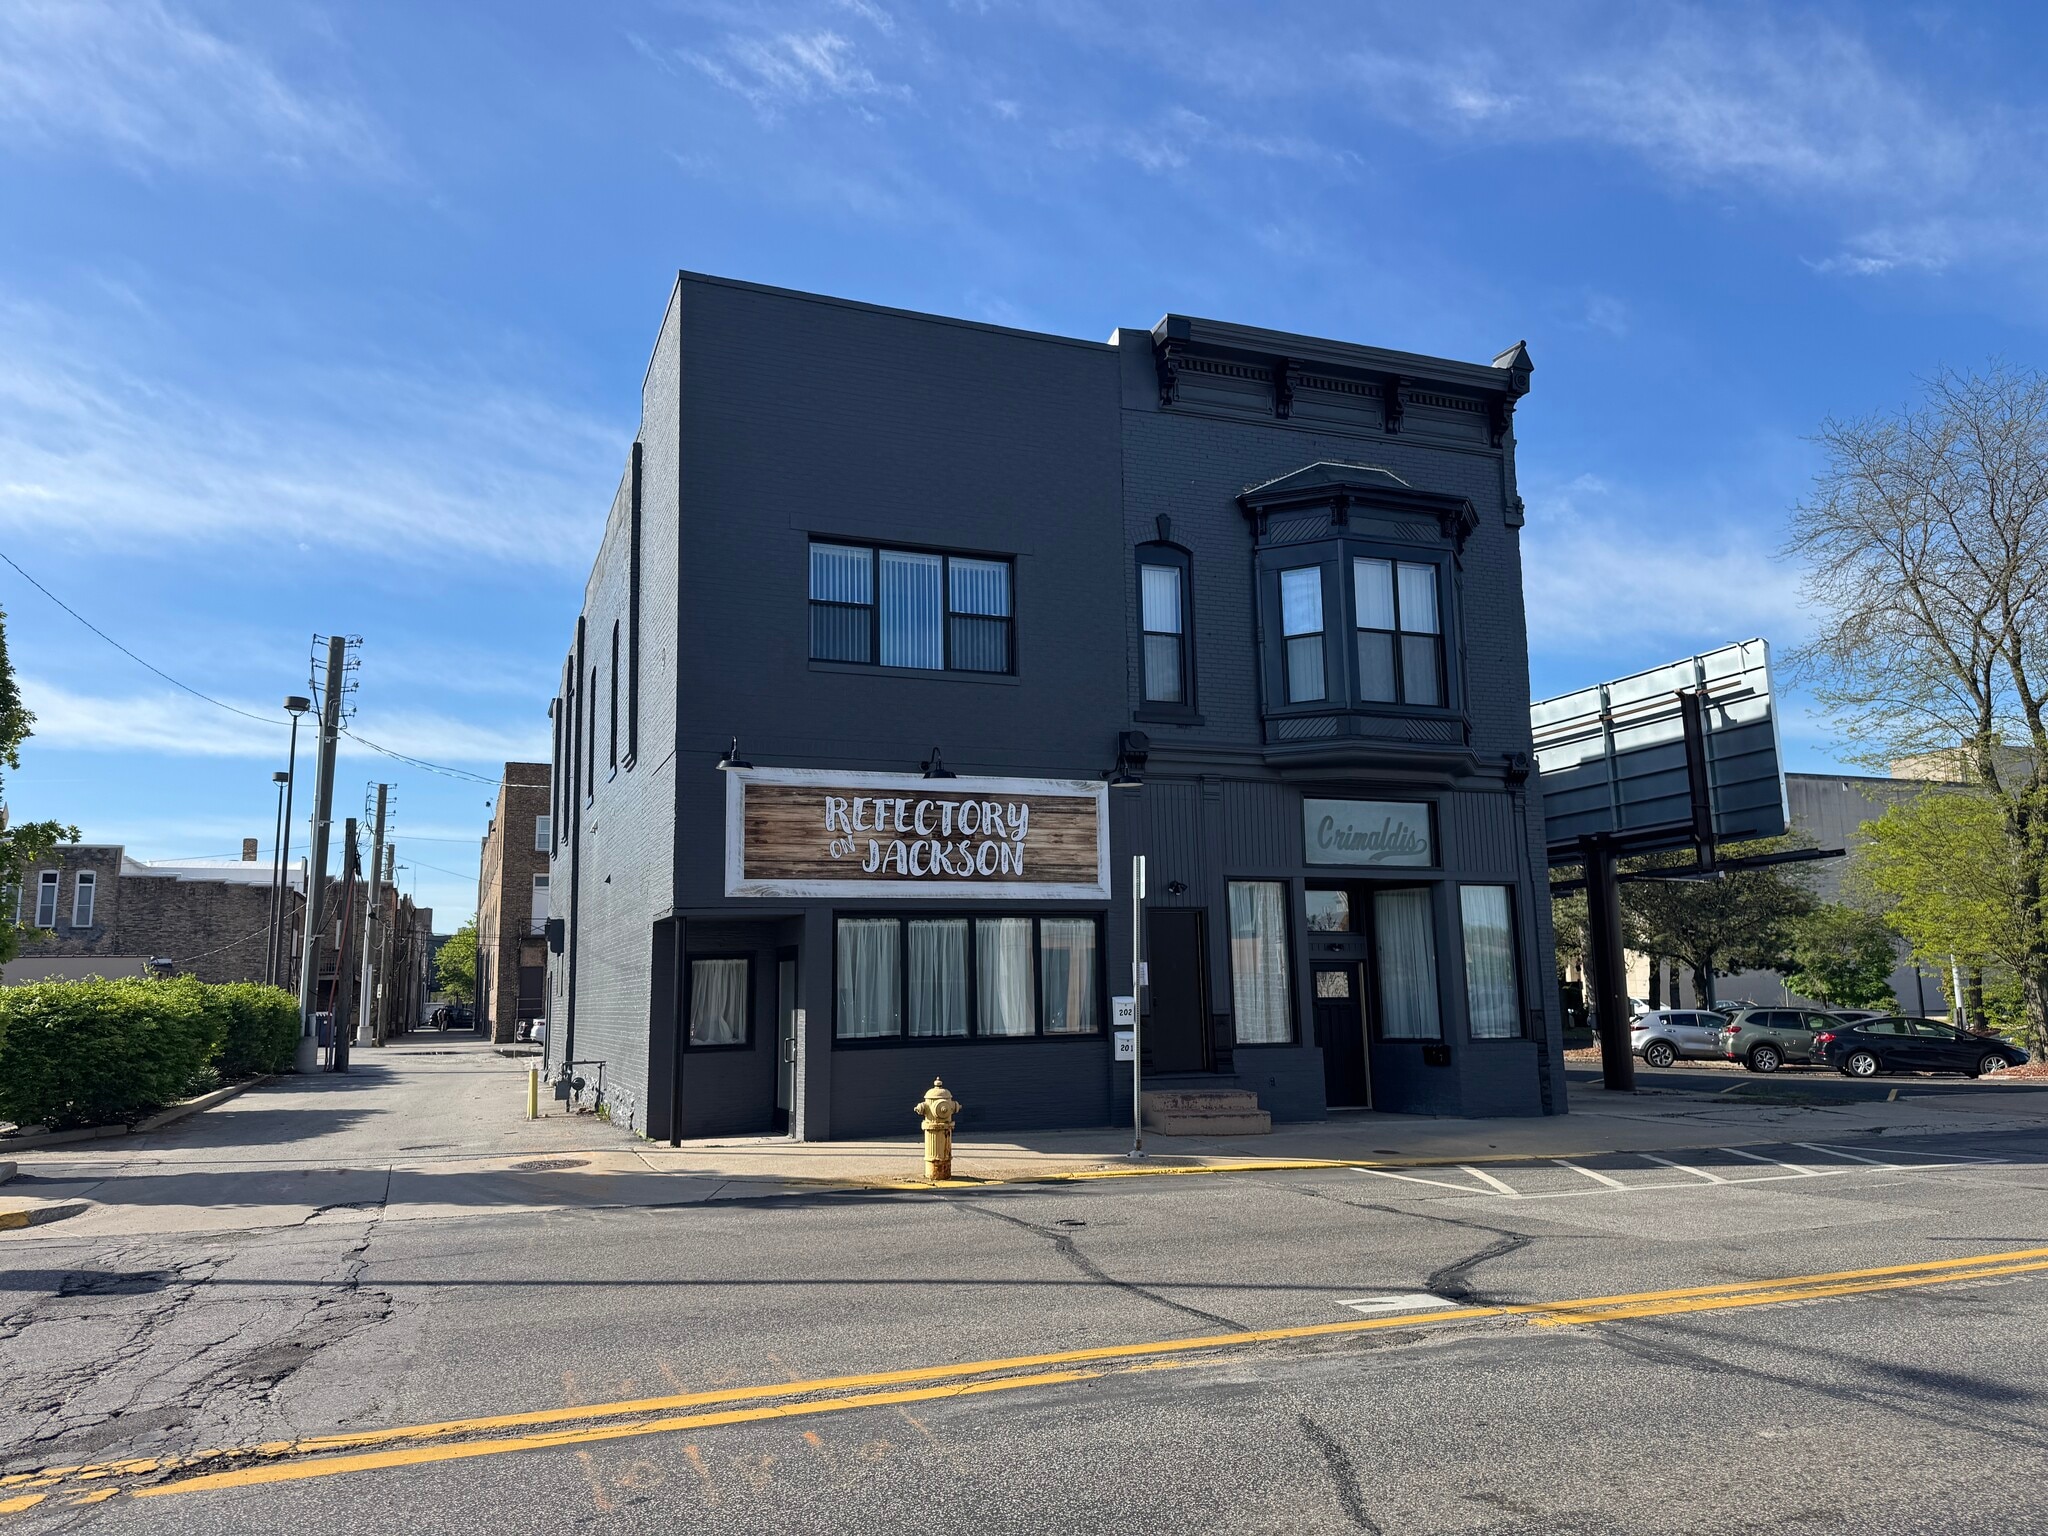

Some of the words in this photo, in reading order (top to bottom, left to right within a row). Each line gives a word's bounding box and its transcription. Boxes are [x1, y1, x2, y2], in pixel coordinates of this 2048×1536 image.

[825, 796, 1029, 841] REFECTORY
[1318, 815, 1427, 860] Crimaldis
[829, 834, 856, 859] ON
[862, 838, 1025, 877] JACKSON
[1120, 1044, 1133, 1052] 201
